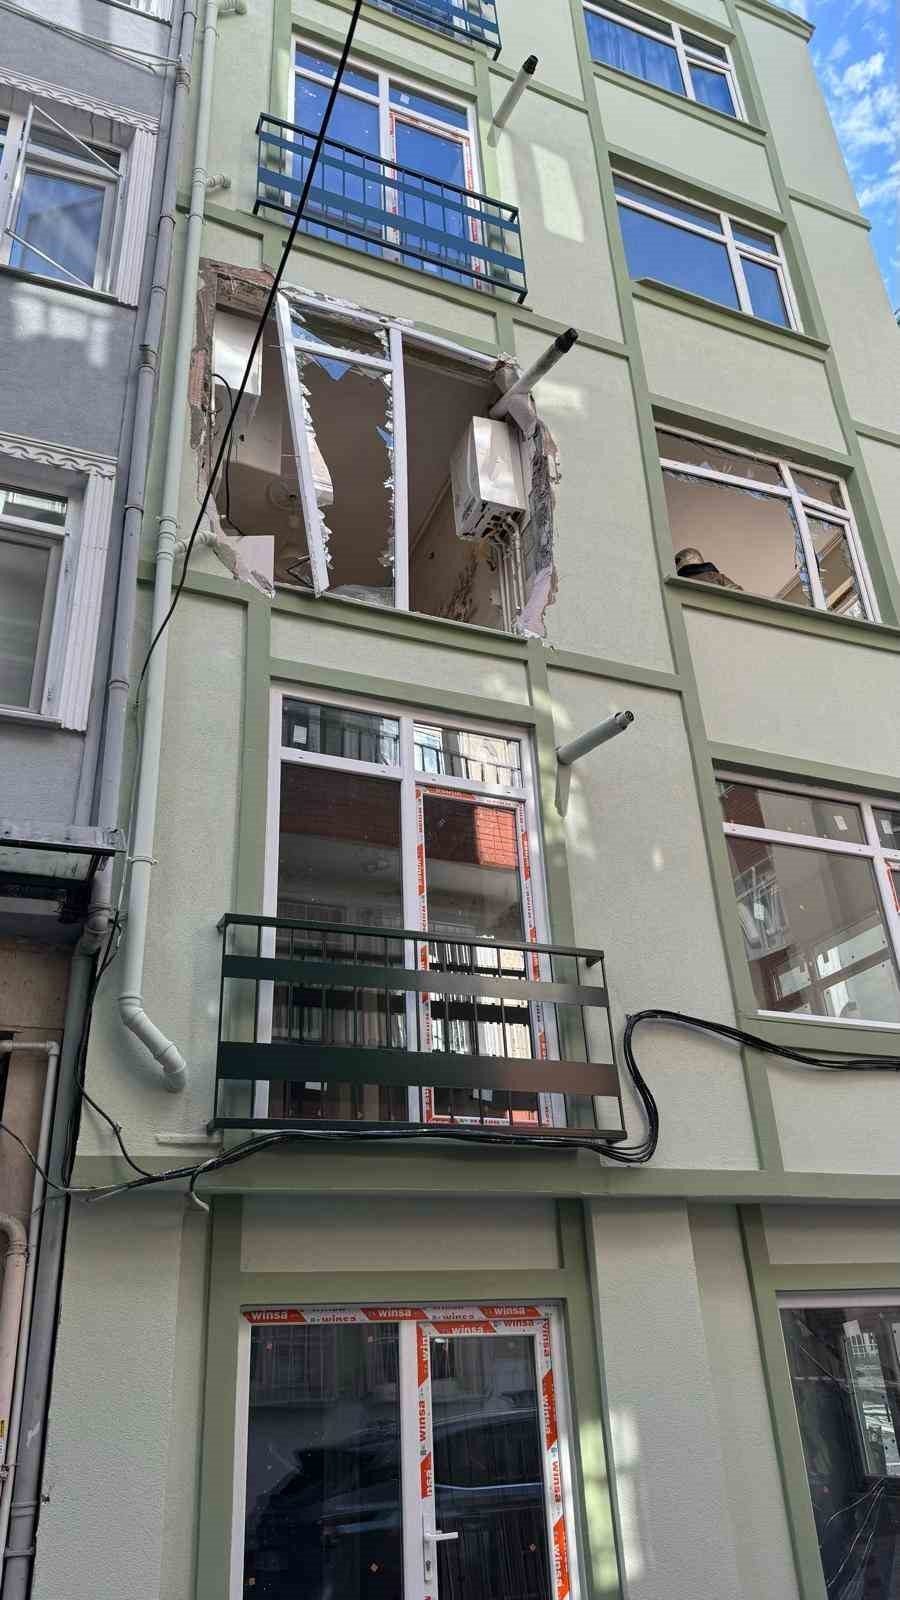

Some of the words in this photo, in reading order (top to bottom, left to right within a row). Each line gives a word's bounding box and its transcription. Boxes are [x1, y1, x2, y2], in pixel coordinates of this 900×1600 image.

[253, 1310, 289, 1320] winsa
[378, 1306, 412, 1317] winsa
[494, 1305, 527, 1315] winsa
[503, 1319, 535, 1328] winsa
[451, 1325, 484, 1333] winsa
[418, 1400, 426, 1442] winsa
[552, 1461, 561, 1503] winsa
[553, 1544, 563, 1587] winsa
